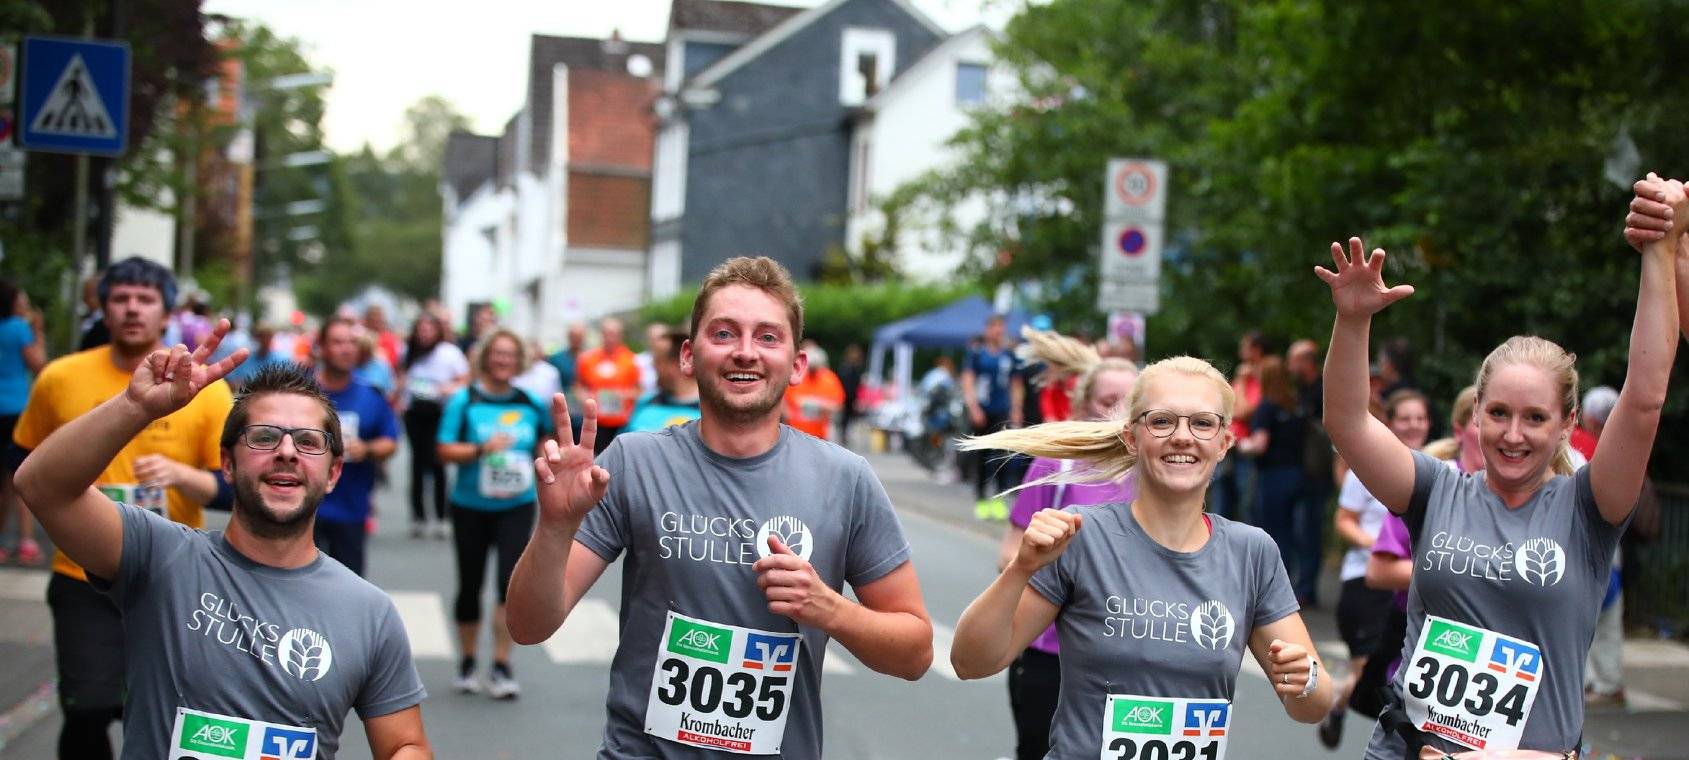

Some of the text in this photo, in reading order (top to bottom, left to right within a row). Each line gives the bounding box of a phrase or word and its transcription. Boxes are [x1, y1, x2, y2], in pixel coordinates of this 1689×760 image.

[661, 511, 755, 539] GLÜCKS
[659, 536, 755, 565] STULLE
[1432, 531, 1514, 560] GLÜCKS
[1423, 550, 1513, 581] STULLE
[1105, 595, 1189, 620] GLÜCKS
[187, 609, 277, 666] STULLE
[678, 628, 721, 651] AOK
[1103, 616, 1189, 643] STULLE
[1434, 628, 1473, 651] AOK
[657, 657, 788, 722] 3035
[1408, 656, 1529, 727] 3034
[680, 711, 756, 741] Krombacher
[1123, 705, 1164, 724] AOK
[192, 723, 240, 746] AOK
[682, 733, 747, 749] ALKOHOLFREI
[1426, 724, 1483, 746] ALKOHOLFREI
